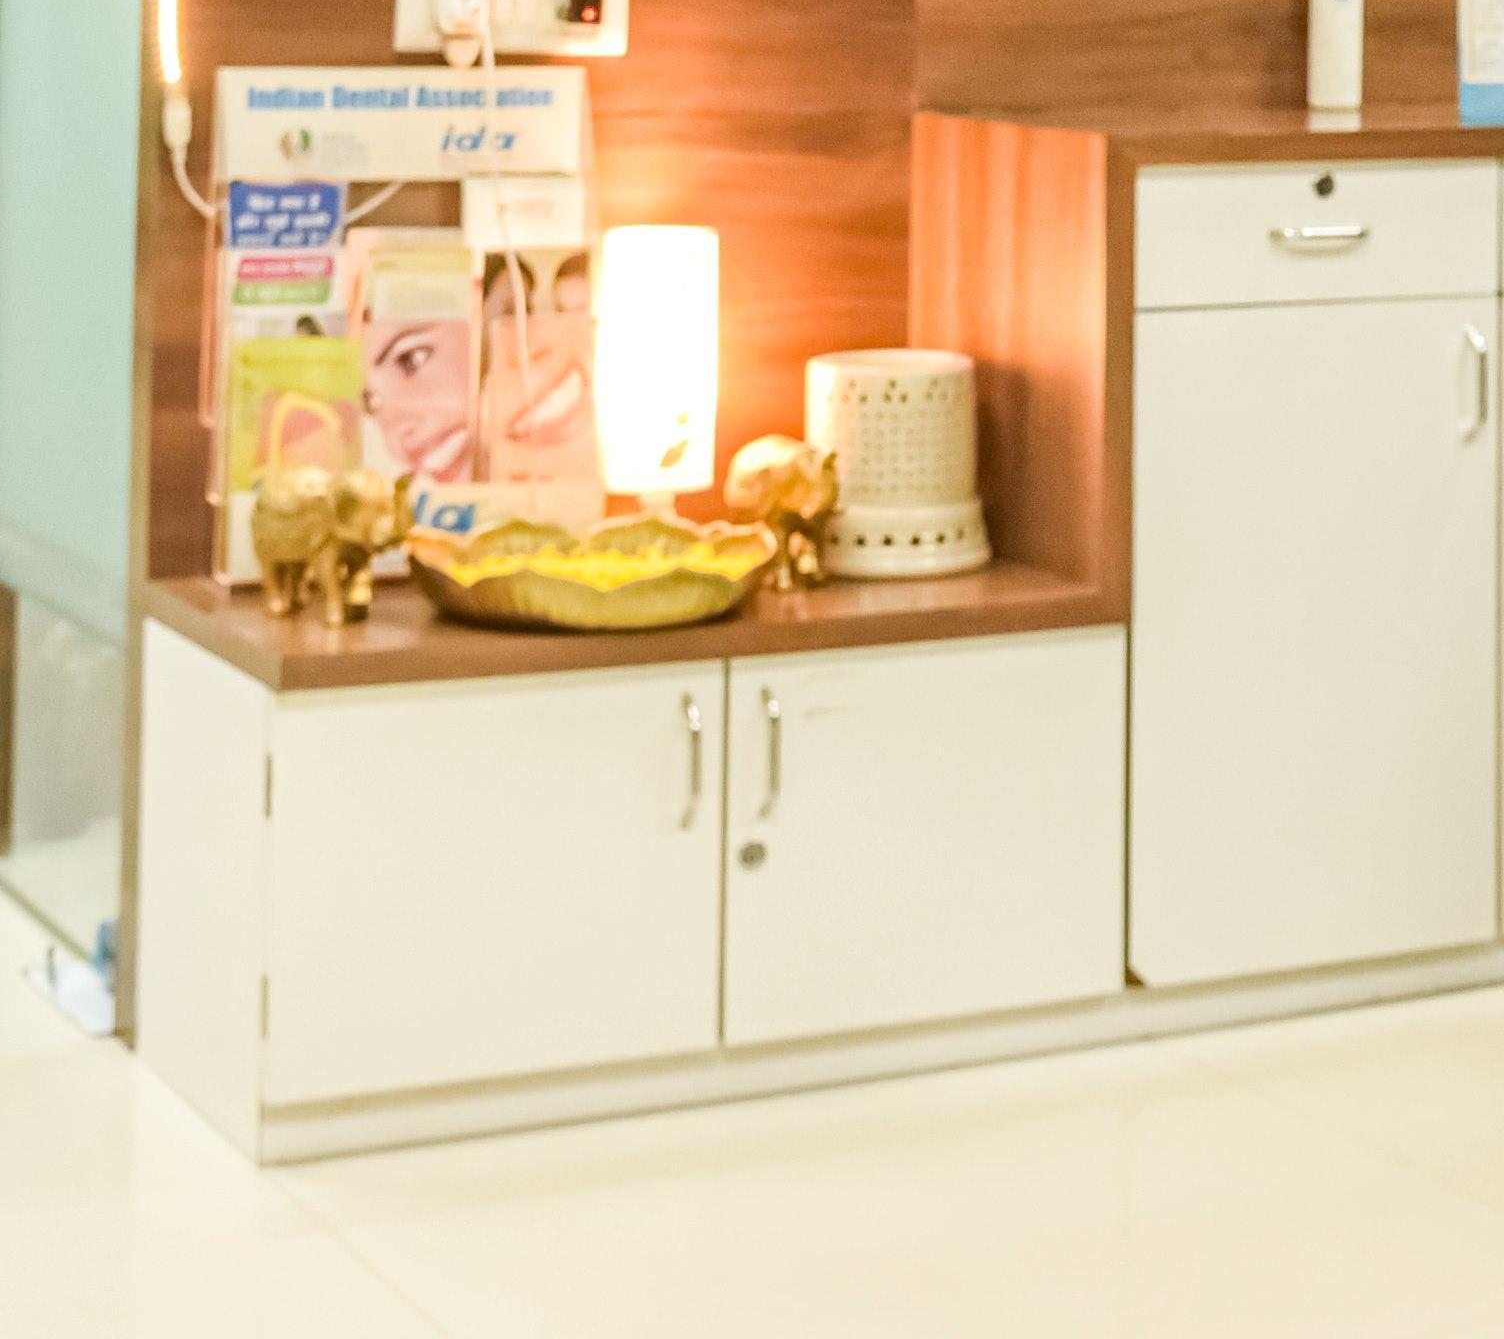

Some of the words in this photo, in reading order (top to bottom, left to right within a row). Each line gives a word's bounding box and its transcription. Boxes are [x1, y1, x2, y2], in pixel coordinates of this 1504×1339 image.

[247, 86, 325, 110] Indian
[332, 84, 410, 110] Dental
[415, 84, 554, 108] Assocation
